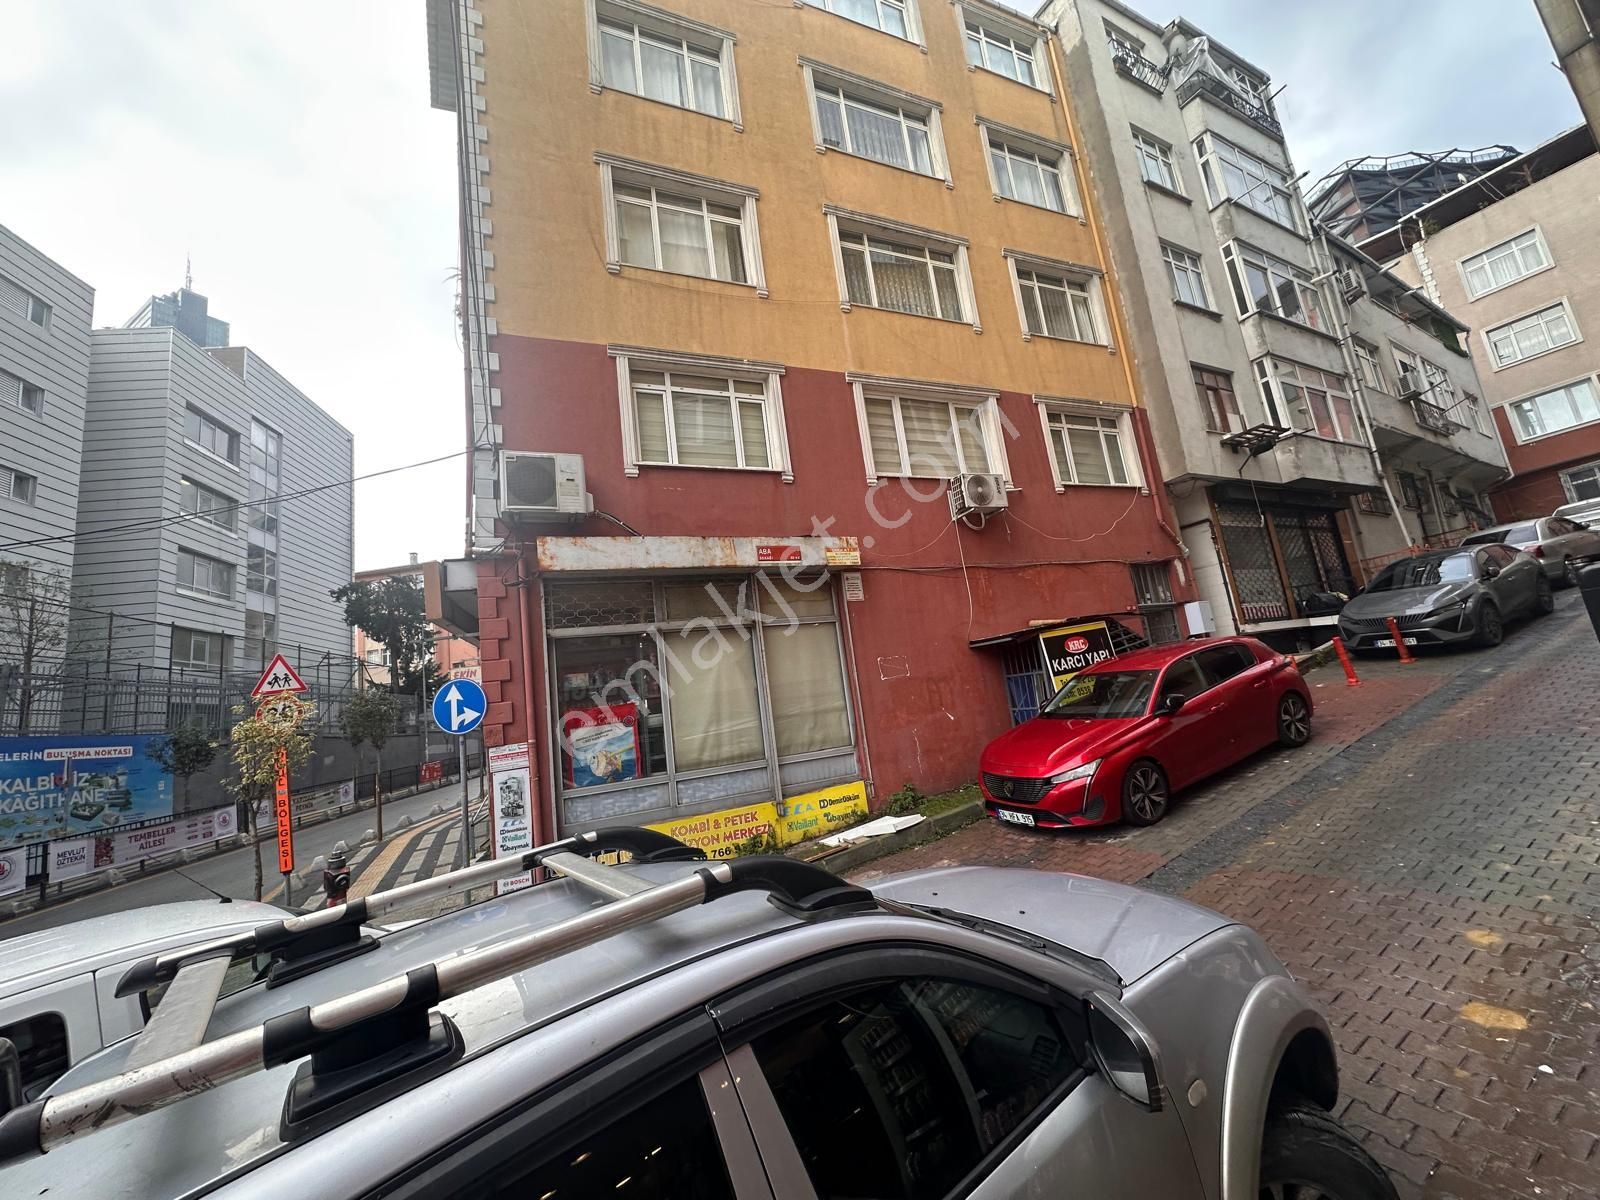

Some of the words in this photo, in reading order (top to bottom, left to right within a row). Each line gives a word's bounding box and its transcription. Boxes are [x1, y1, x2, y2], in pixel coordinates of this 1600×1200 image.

[1067, 639, 1086, 651] KRC
[1052, 655, 1086, 672] KARCI
[713, 818, 722, 830] &
[723, 811, 759, 829] PETEK
[128, 826, 177, 844] TEMBELLER
[711, 846, 731, 858] 766
[510, 877, 530, 886] BOSCH
